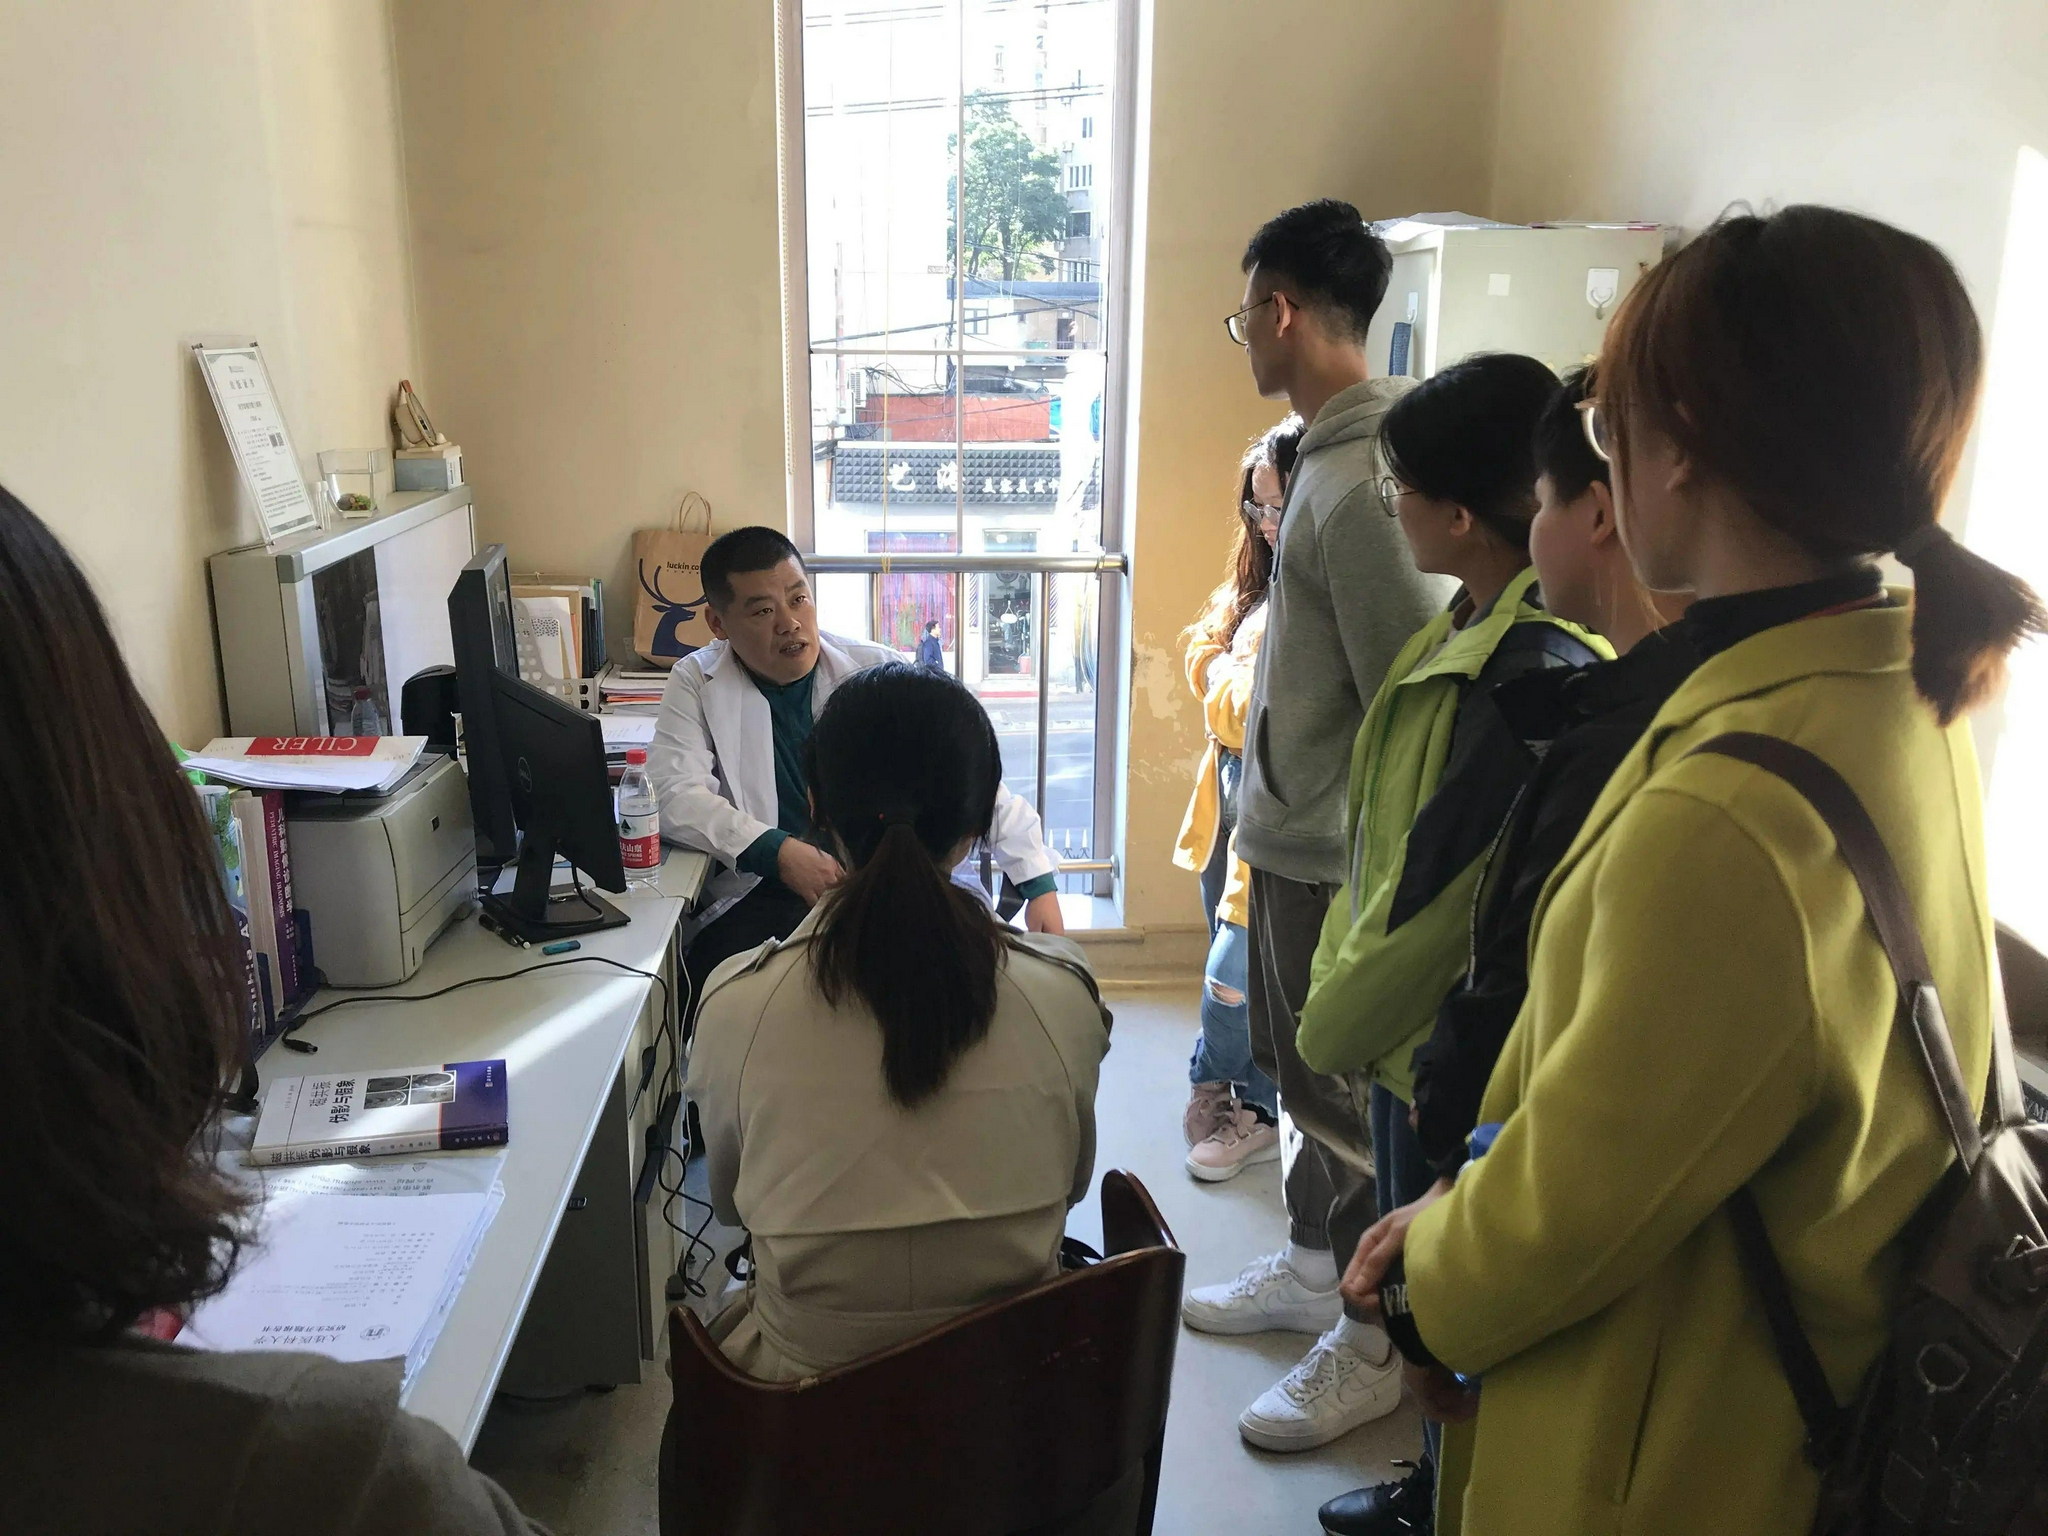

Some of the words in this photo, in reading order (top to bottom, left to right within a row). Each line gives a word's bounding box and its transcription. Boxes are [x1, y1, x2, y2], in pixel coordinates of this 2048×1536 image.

[666, 561, 690, 571] luckin
[272, 737, 359, 752] CILER
[269, 811, 278, 848] PEDIATRIC
[272, 850, 281, 880] IMAGING
[276, 881, 286, 919] DIAGNOSIS
[309, 1081, 331, 1108] 磁共振
[328, 1078, 356, 1124] 伪影与假象
[252, 1333, 342, 1346] 大连医科大学
